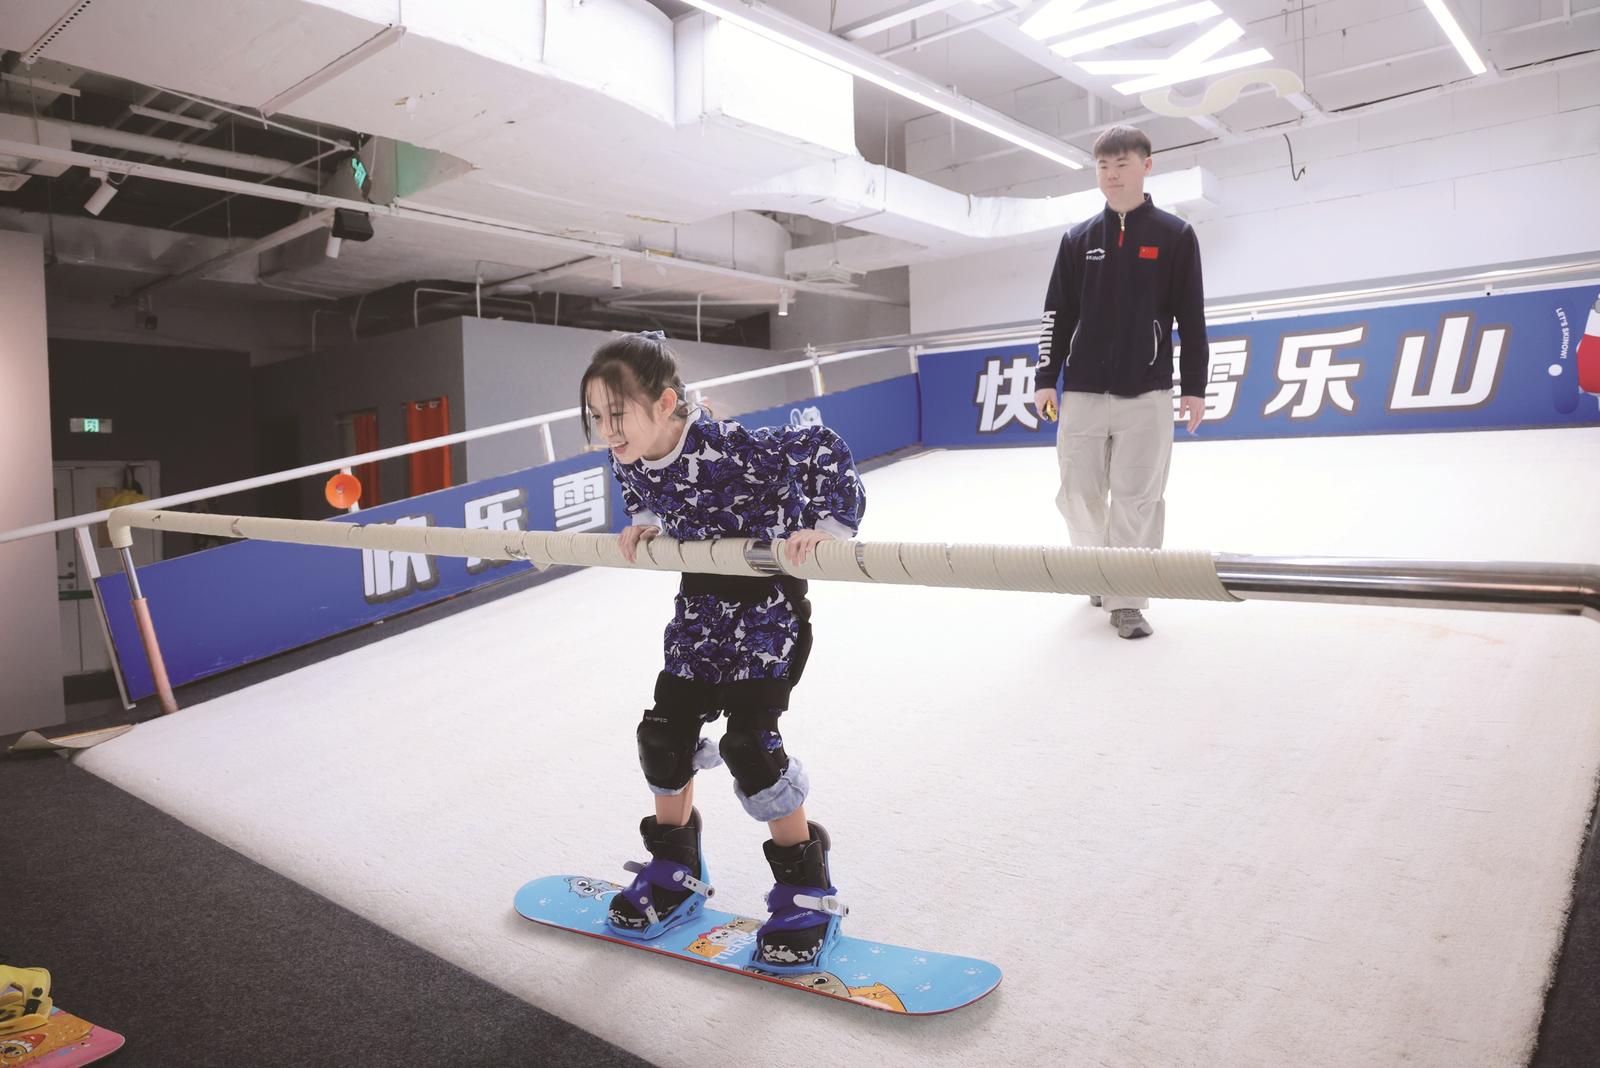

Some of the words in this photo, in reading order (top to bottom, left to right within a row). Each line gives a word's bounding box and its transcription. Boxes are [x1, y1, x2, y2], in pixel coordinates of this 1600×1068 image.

[1036, 310, 1057, 369] CHINA
[1555, 307, 1568, 327] LET'S
[975, 315, 1507, 432] 快雪乐山
